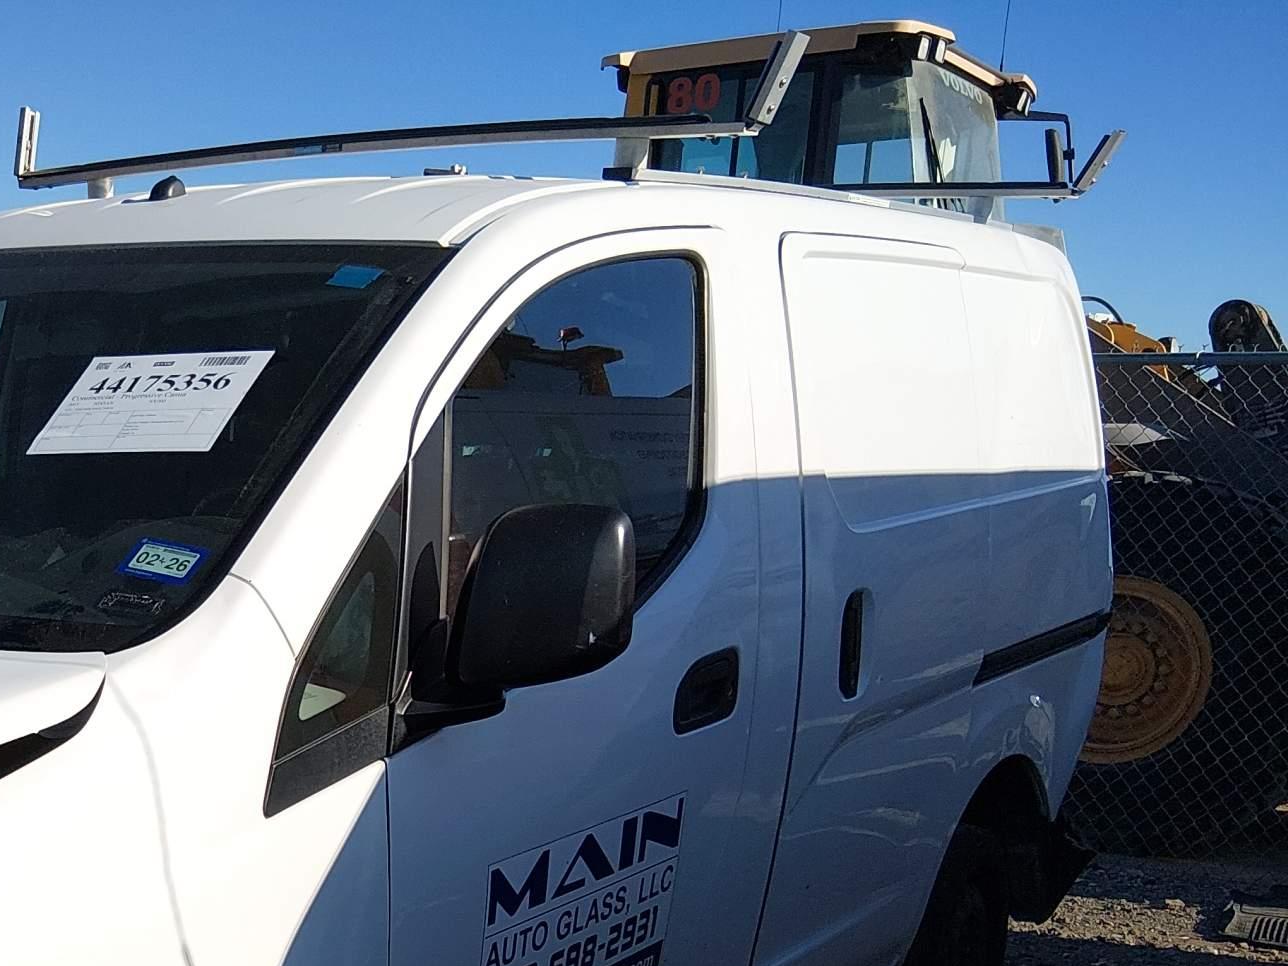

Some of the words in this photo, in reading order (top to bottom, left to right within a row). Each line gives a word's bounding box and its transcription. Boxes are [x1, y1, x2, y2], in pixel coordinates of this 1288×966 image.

[667, 73, 721, 113] 80
[937, 67, 983, 105] VOLVO
[88, 371, 238, 394] 44175356
[487, 797, 685, 927] MAIN
[556, 885, 631, 940] GLASS,
[637, 864, 674, 905] LLC
